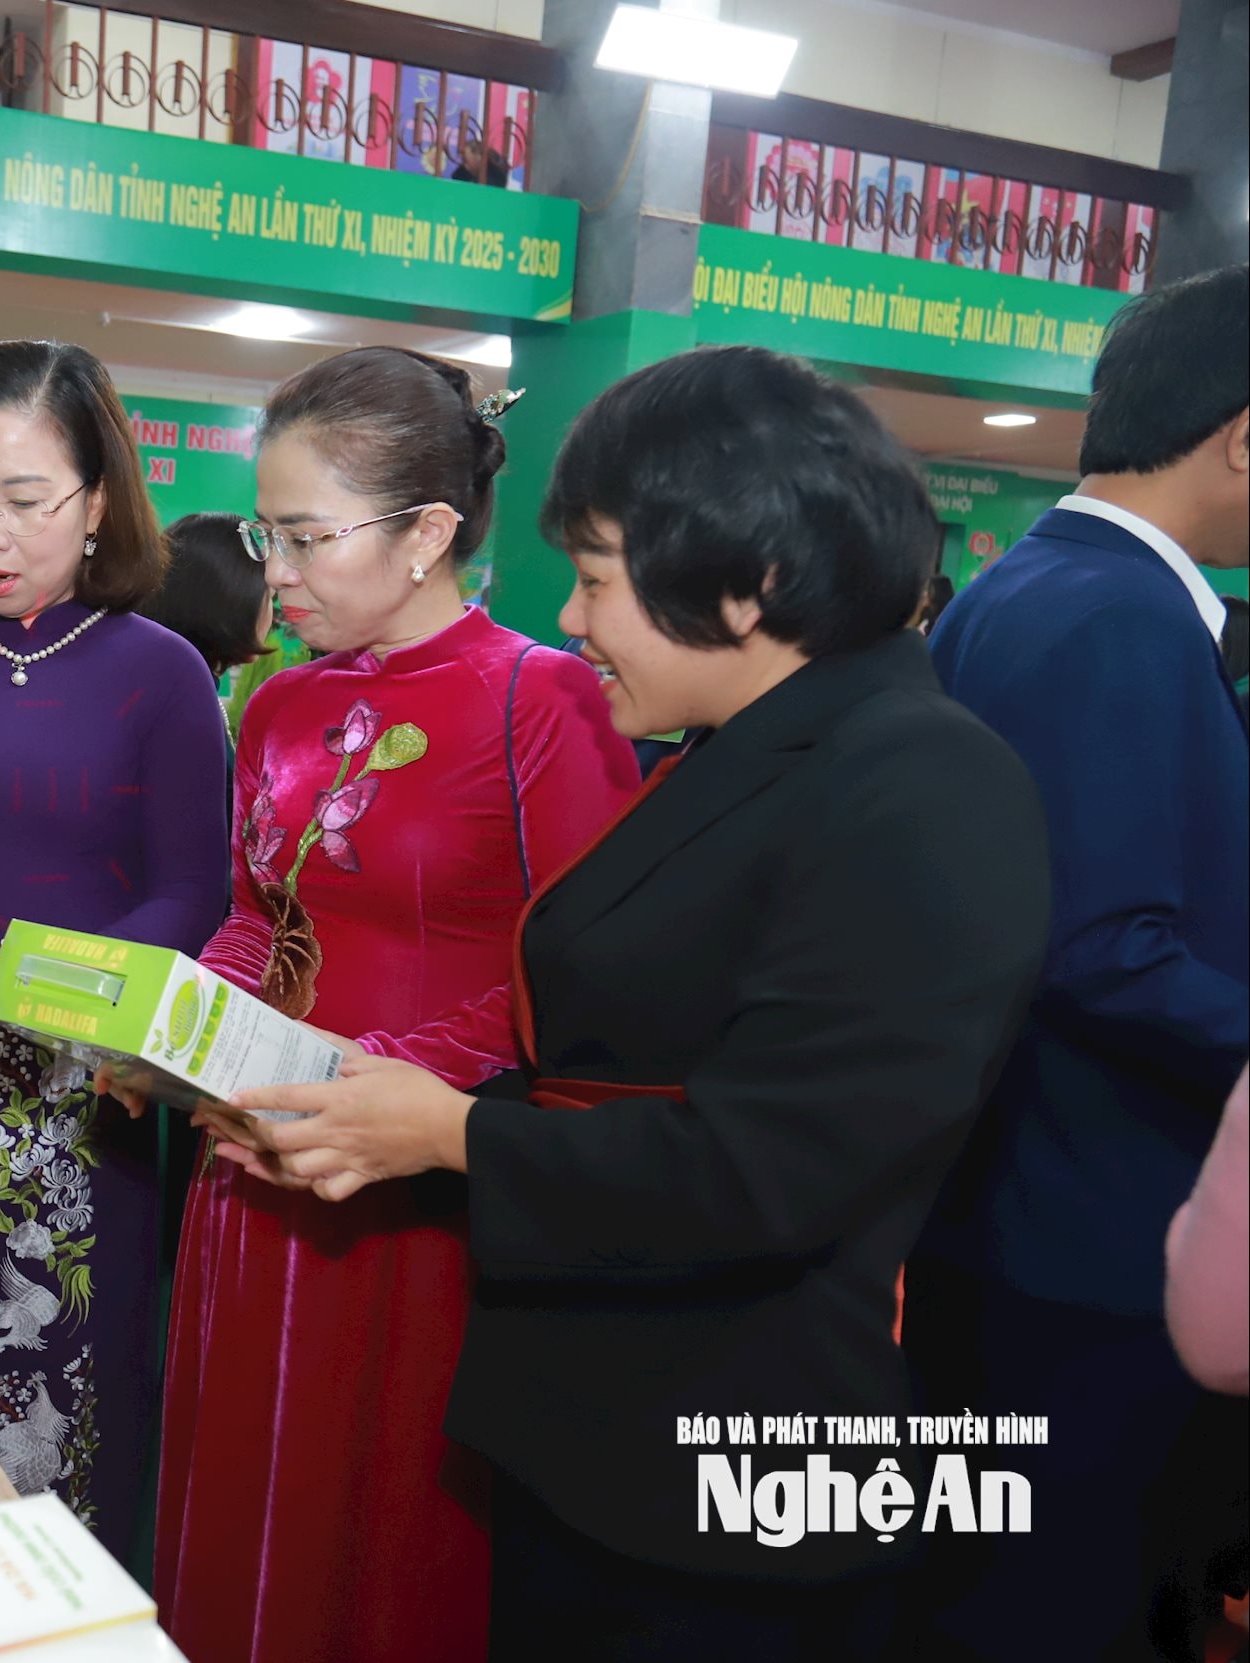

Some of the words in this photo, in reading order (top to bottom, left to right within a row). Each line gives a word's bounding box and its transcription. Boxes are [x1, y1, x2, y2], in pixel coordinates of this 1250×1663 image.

[4, 152, 64, 208] NÔNG
[70, 161, 113, 216] DÂN
[119, 162, 165, 224] TỈNH
[170, 181, 223, 241] NGHỆ
[227, 192, 256, 236] AN
[260, 185, 298, 242] LẦN
[303, 199, 341, 249] THỨ
[342, 209, 366, 257] XI,
[371, 210, 431, 268] NHIỆM
[434, 216, 458, 265] KỲ
[461, 227, 504, 271] 2025
[518, 236, 561, 279] 2030
[693, 256, 711, 309] ỘI
[712, 267, 741, 314] ĐẠI
[742, 260, 779, 312] BIỂU
[780, 272, 808, 324] HỘI
[809, 277, 852, 323] NÔNG
[854, 284, 886, 328] DÂN
[888, 284, 921, 332] TỈNH
[922, 297, 961, 346] NGHỆ
[962, 306, 984, 342] AN
[984, 299, 1013, 346] LẦN
[1015, 309, 1043, 350] THỨ
[132, 411, 178, 448] ỈNH
[149, 457, 175, 484] XI
